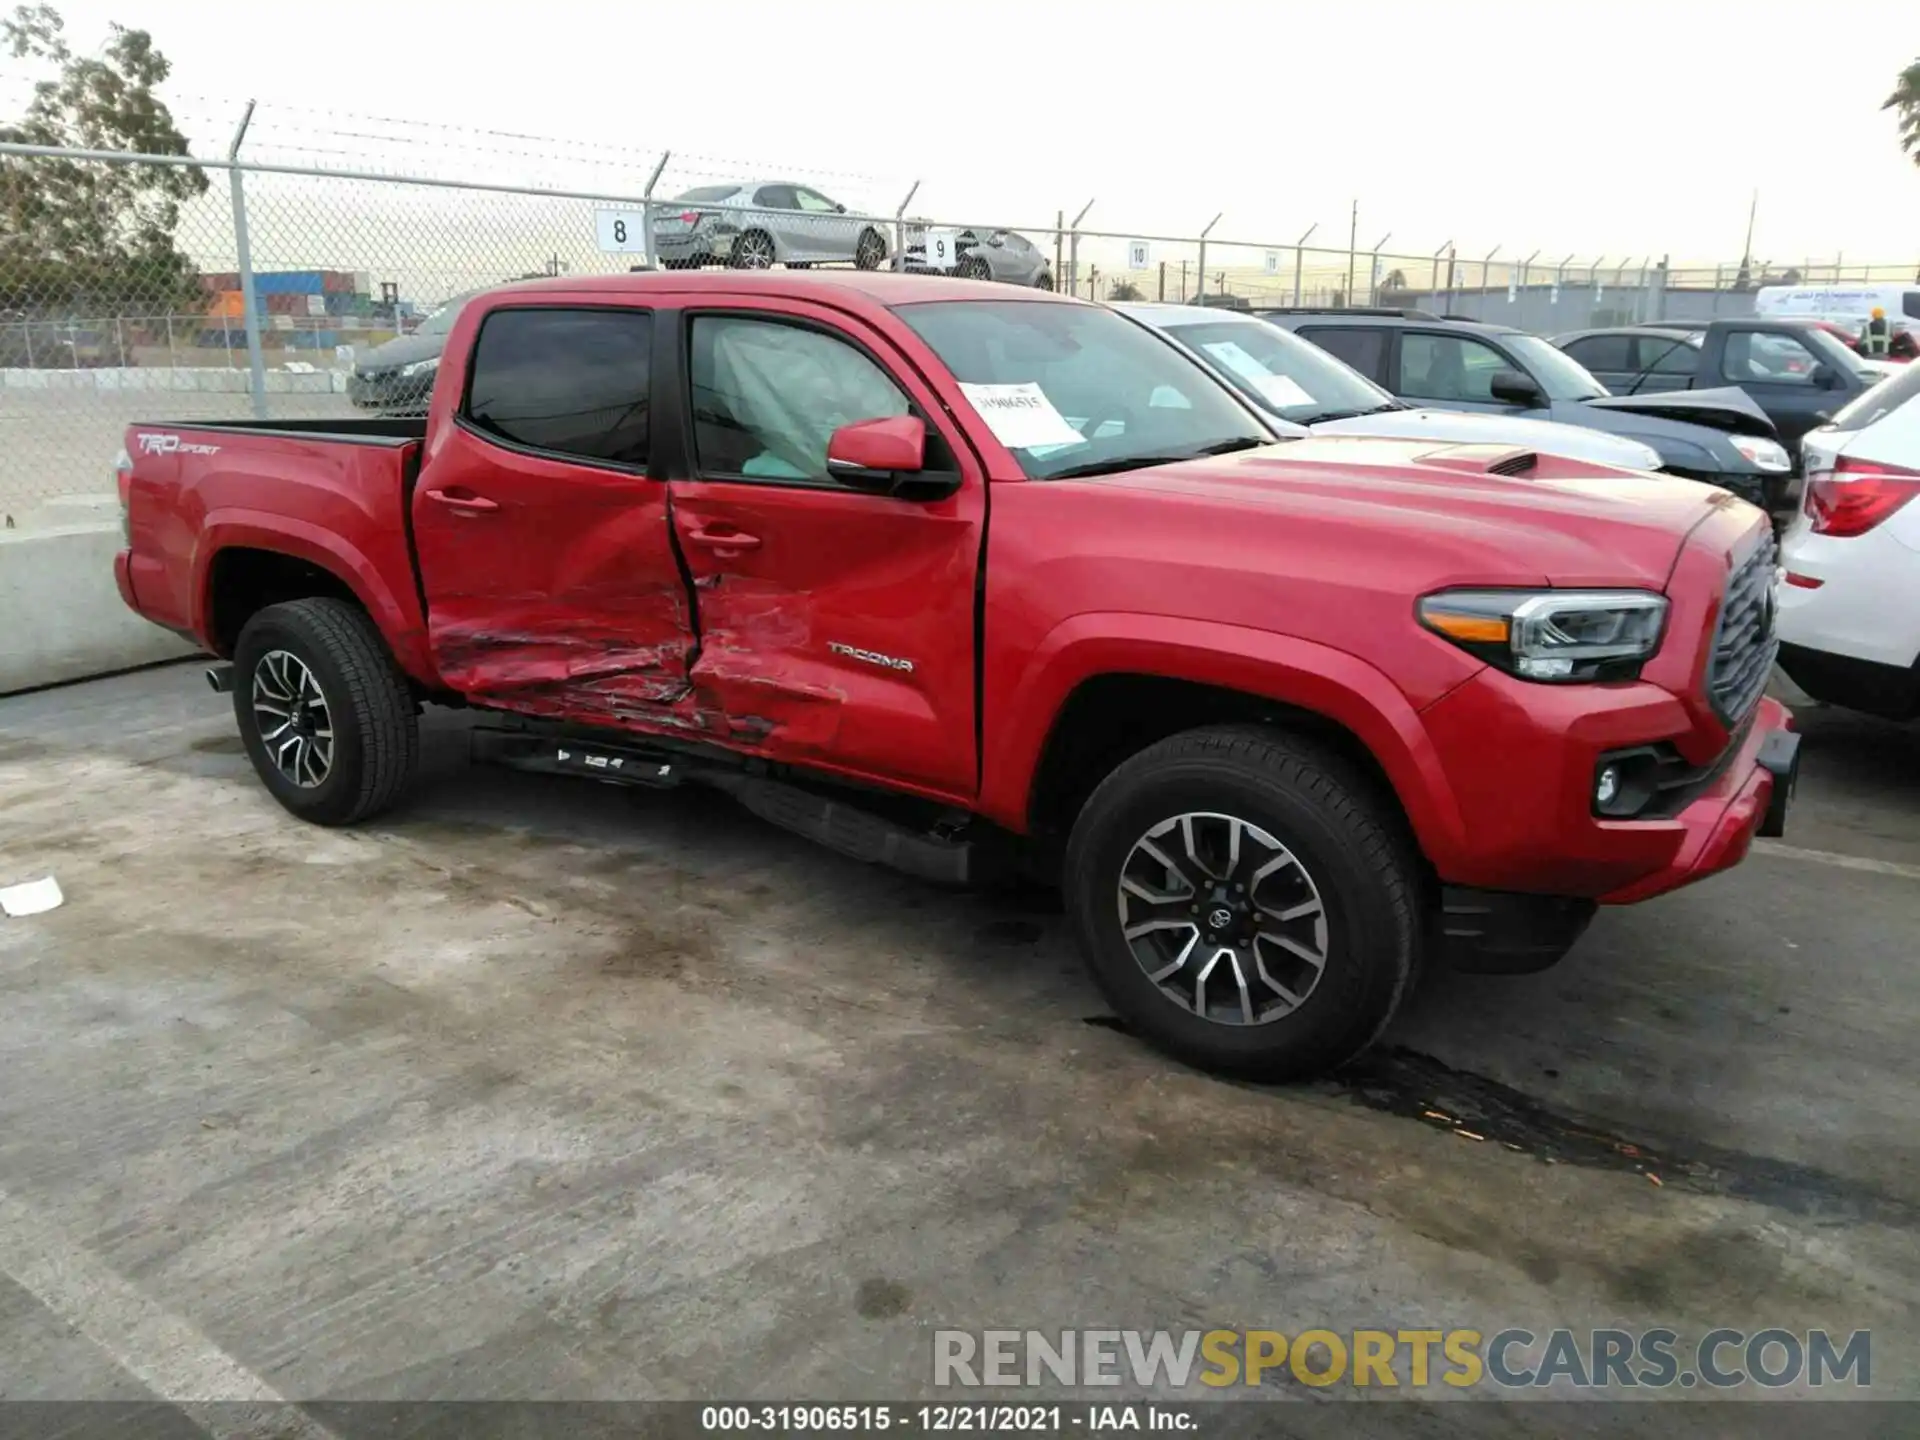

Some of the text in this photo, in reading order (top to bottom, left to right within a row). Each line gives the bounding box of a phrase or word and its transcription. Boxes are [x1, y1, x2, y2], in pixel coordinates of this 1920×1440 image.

[613, 219, 627, 244] 8
[936, 239, 945, 258] 9
[1134, 248, 1145, 263] 10
[137, 433, 222, 456] TRD SPORT
[826, 640, 914, 673] TACOMA
